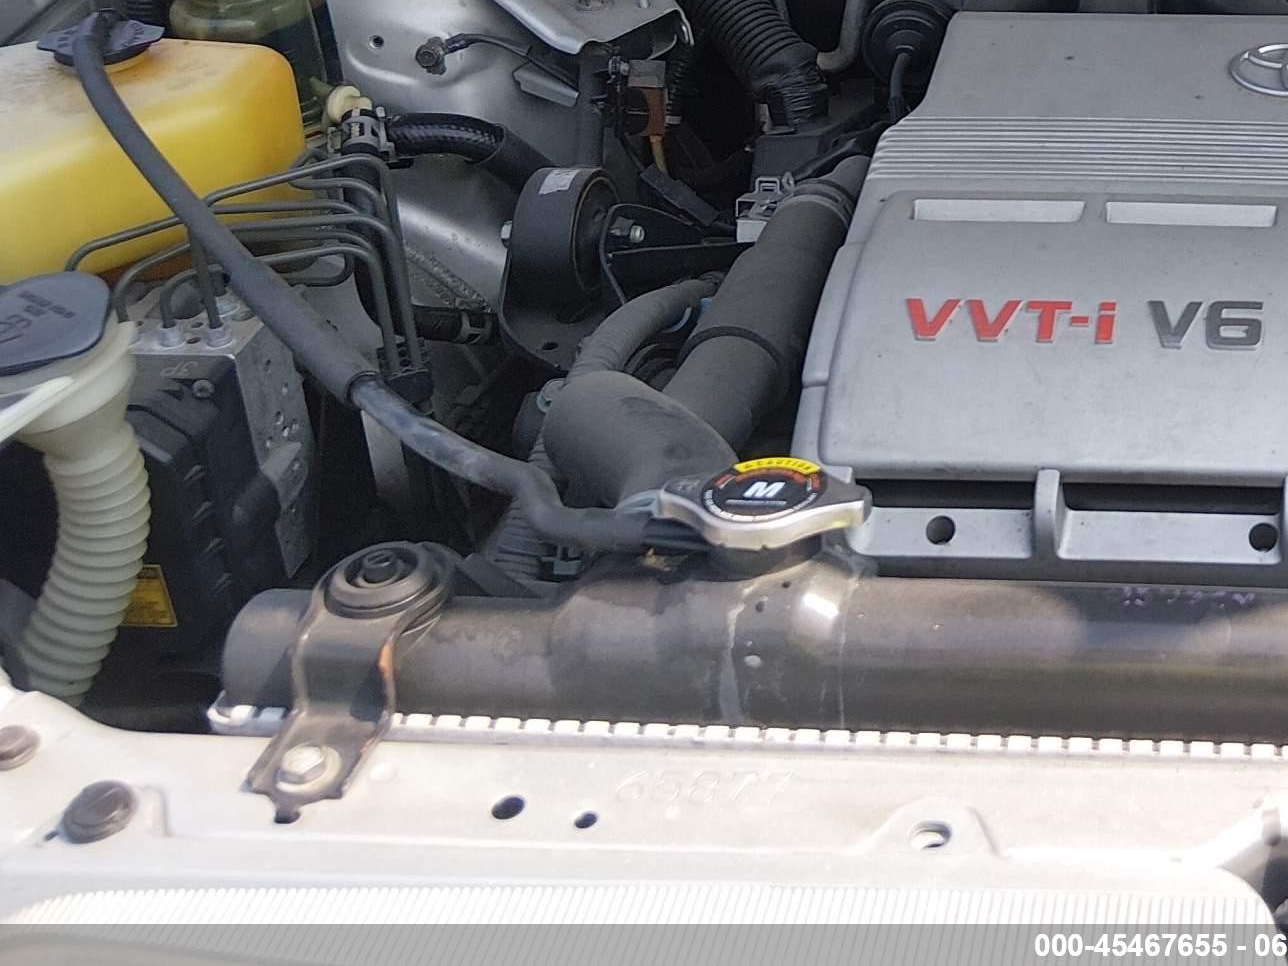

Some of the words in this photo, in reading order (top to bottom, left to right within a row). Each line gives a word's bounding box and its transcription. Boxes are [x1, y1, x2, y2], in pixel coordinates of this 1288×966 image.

[907, 297, 1117, 344] VVT-i
[1147, 300, 1264, 351] V6
[743, 481, 786, 498] M
